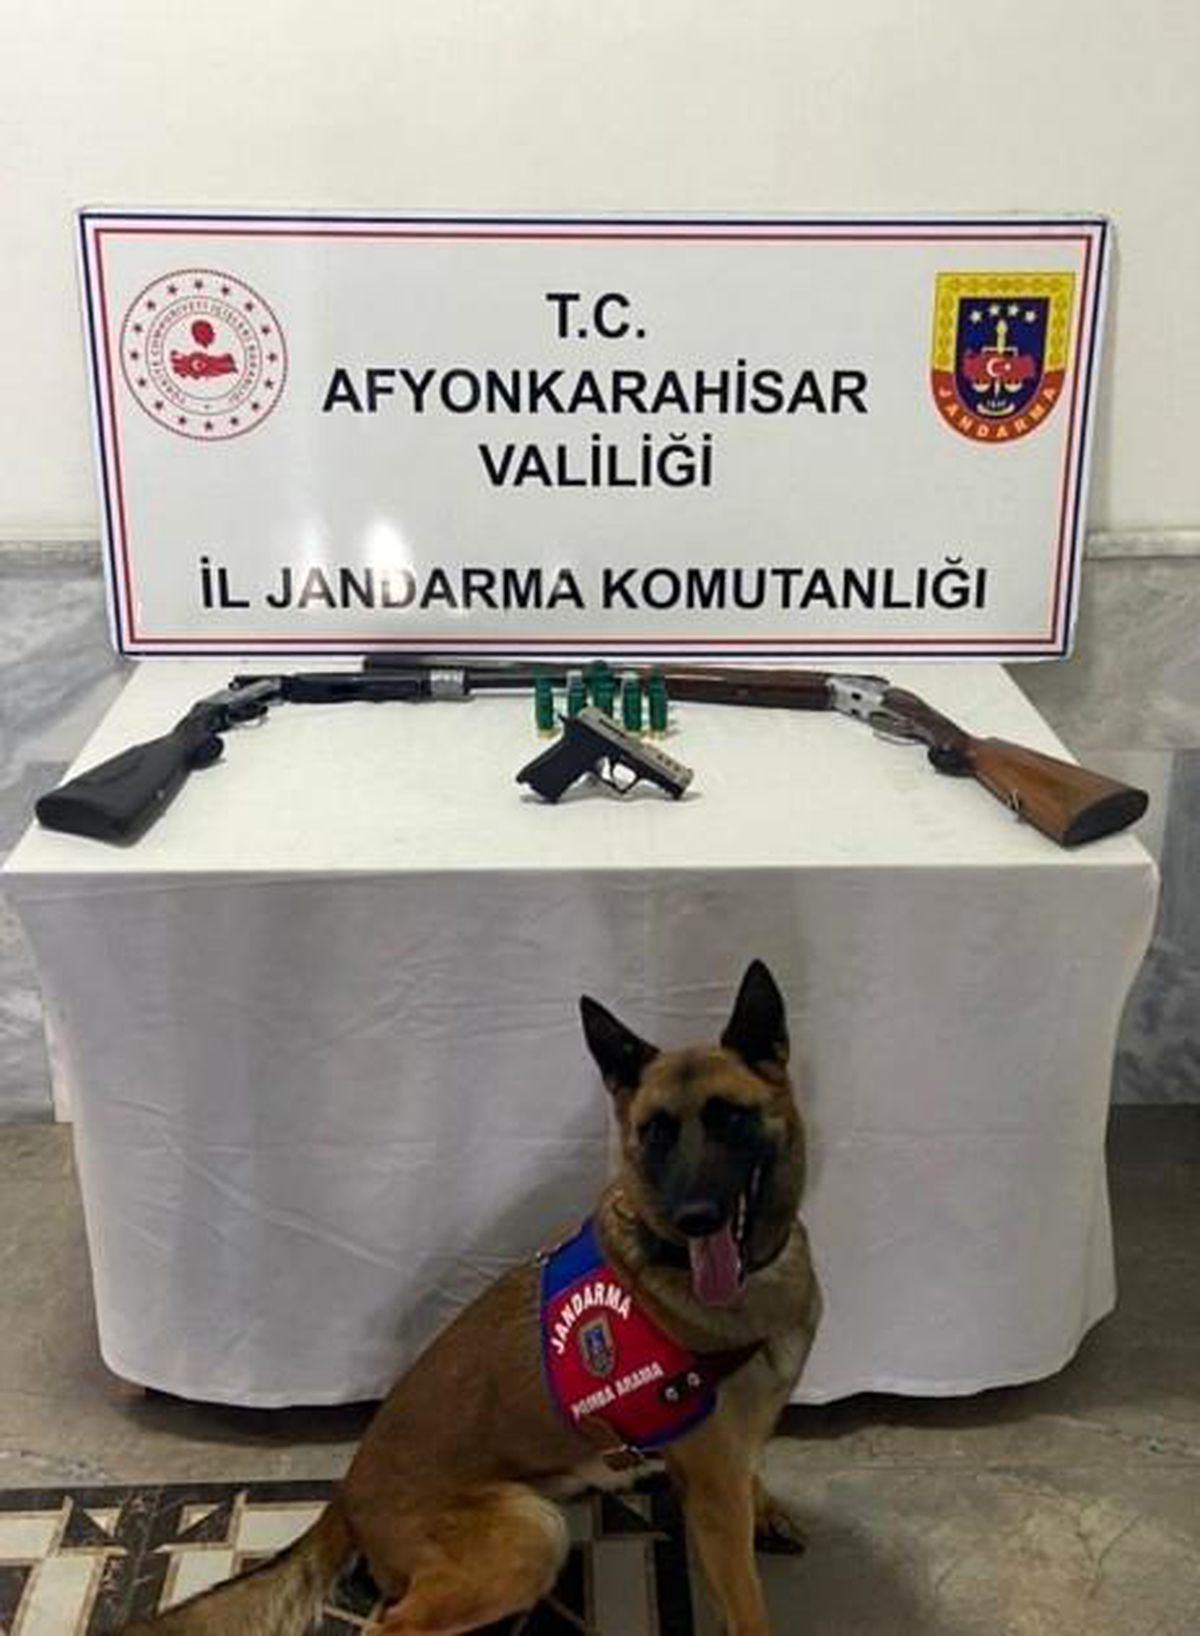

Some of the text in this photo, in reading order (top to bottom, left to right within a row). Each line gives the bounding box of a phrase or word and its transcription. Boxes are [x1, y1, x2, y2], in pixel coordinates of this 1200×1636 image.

[546, 293, 645, 339] T.C.
[322, 358, 868, 414] AFYONKARAHİSAR
[939, 387, 1057, 438] JANDARMA
[478, 432, 712, 487] VALİLİĞİ
[200, 556, 987, 610] İL JANDARMA KOMUTANLIĞI
[551, 1283, 632, 1355] JANDARMA
